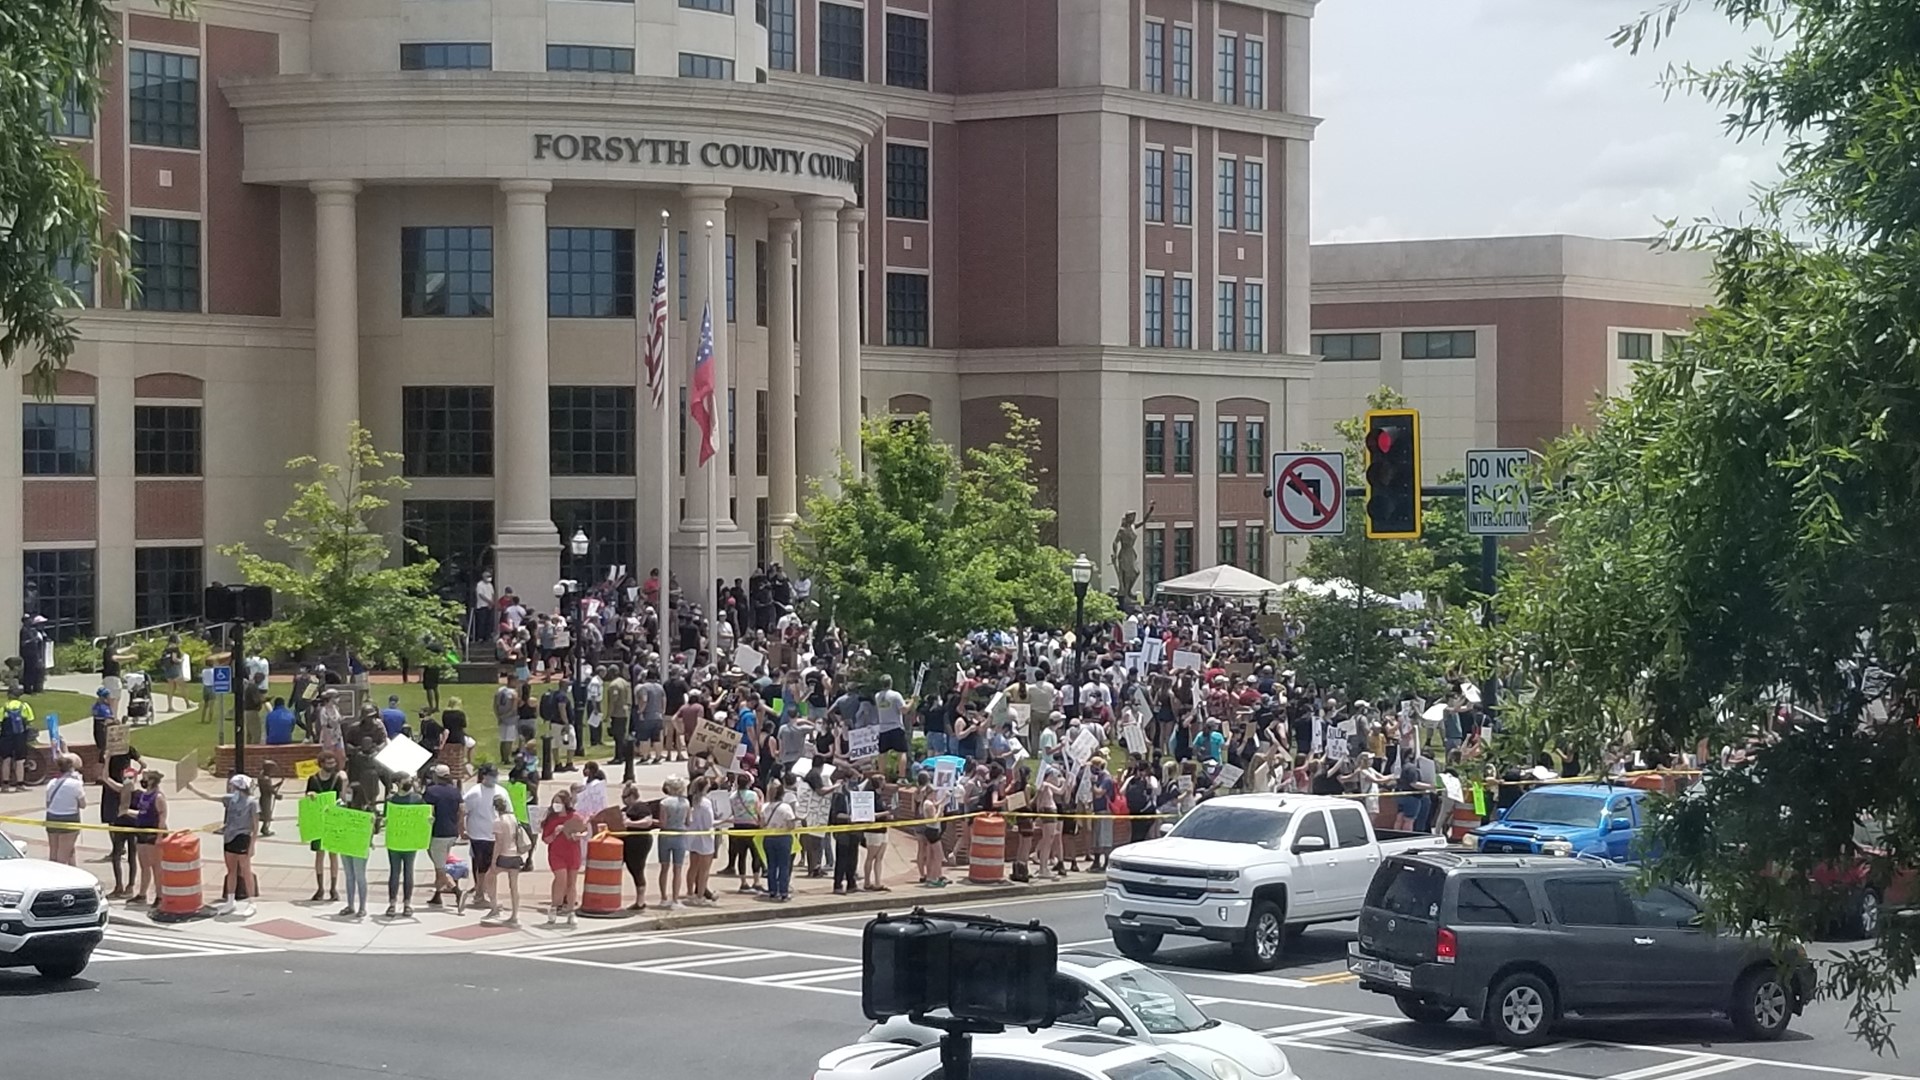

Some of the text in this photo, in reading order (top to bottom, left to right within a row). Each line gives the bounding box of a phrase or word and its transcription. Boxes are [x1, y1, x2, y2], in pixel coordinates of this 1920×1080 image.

[534, 133, 691, 166] FORSYTH
[700, 142, 804, 176] COUNTY
[1470, 457, 1526, 479] DO NOT
